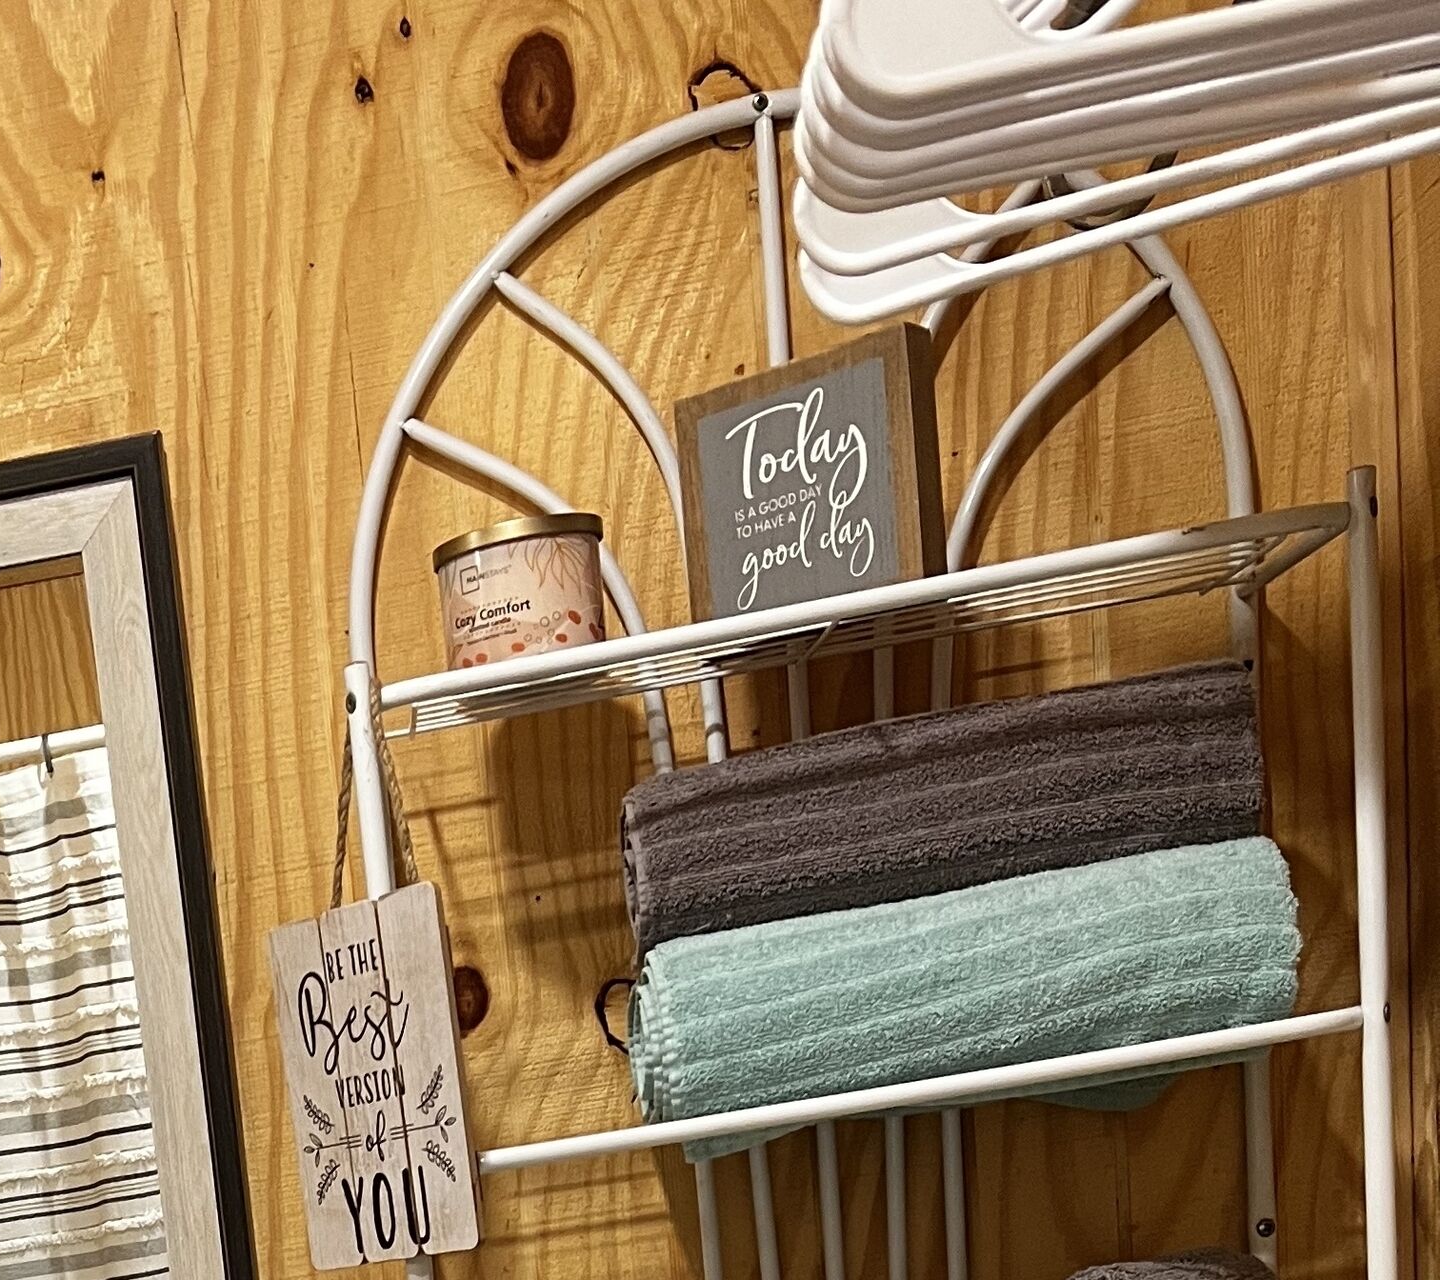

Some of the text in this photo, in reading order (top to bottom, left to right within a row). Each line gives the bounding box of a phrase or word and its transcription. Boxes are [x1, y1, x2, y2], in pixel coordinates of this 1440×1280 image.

[725, 386, 868, 510] Today
[733, 484, 823, 525] IS A GOOD DAY
[735, 513, 797, 540] TO HAVE A
[737, 490, 875, 611] good day
[455, 600, 530, 629] Cozy Comfort
[326, 939, 379, 983] BE THE
[297, 971, 409, 1075] Best
[335, 1066, 405, 1109] VERSION
[365, 1109, 388, 1161] of
[342, 1166, 430, 1253] YOU
